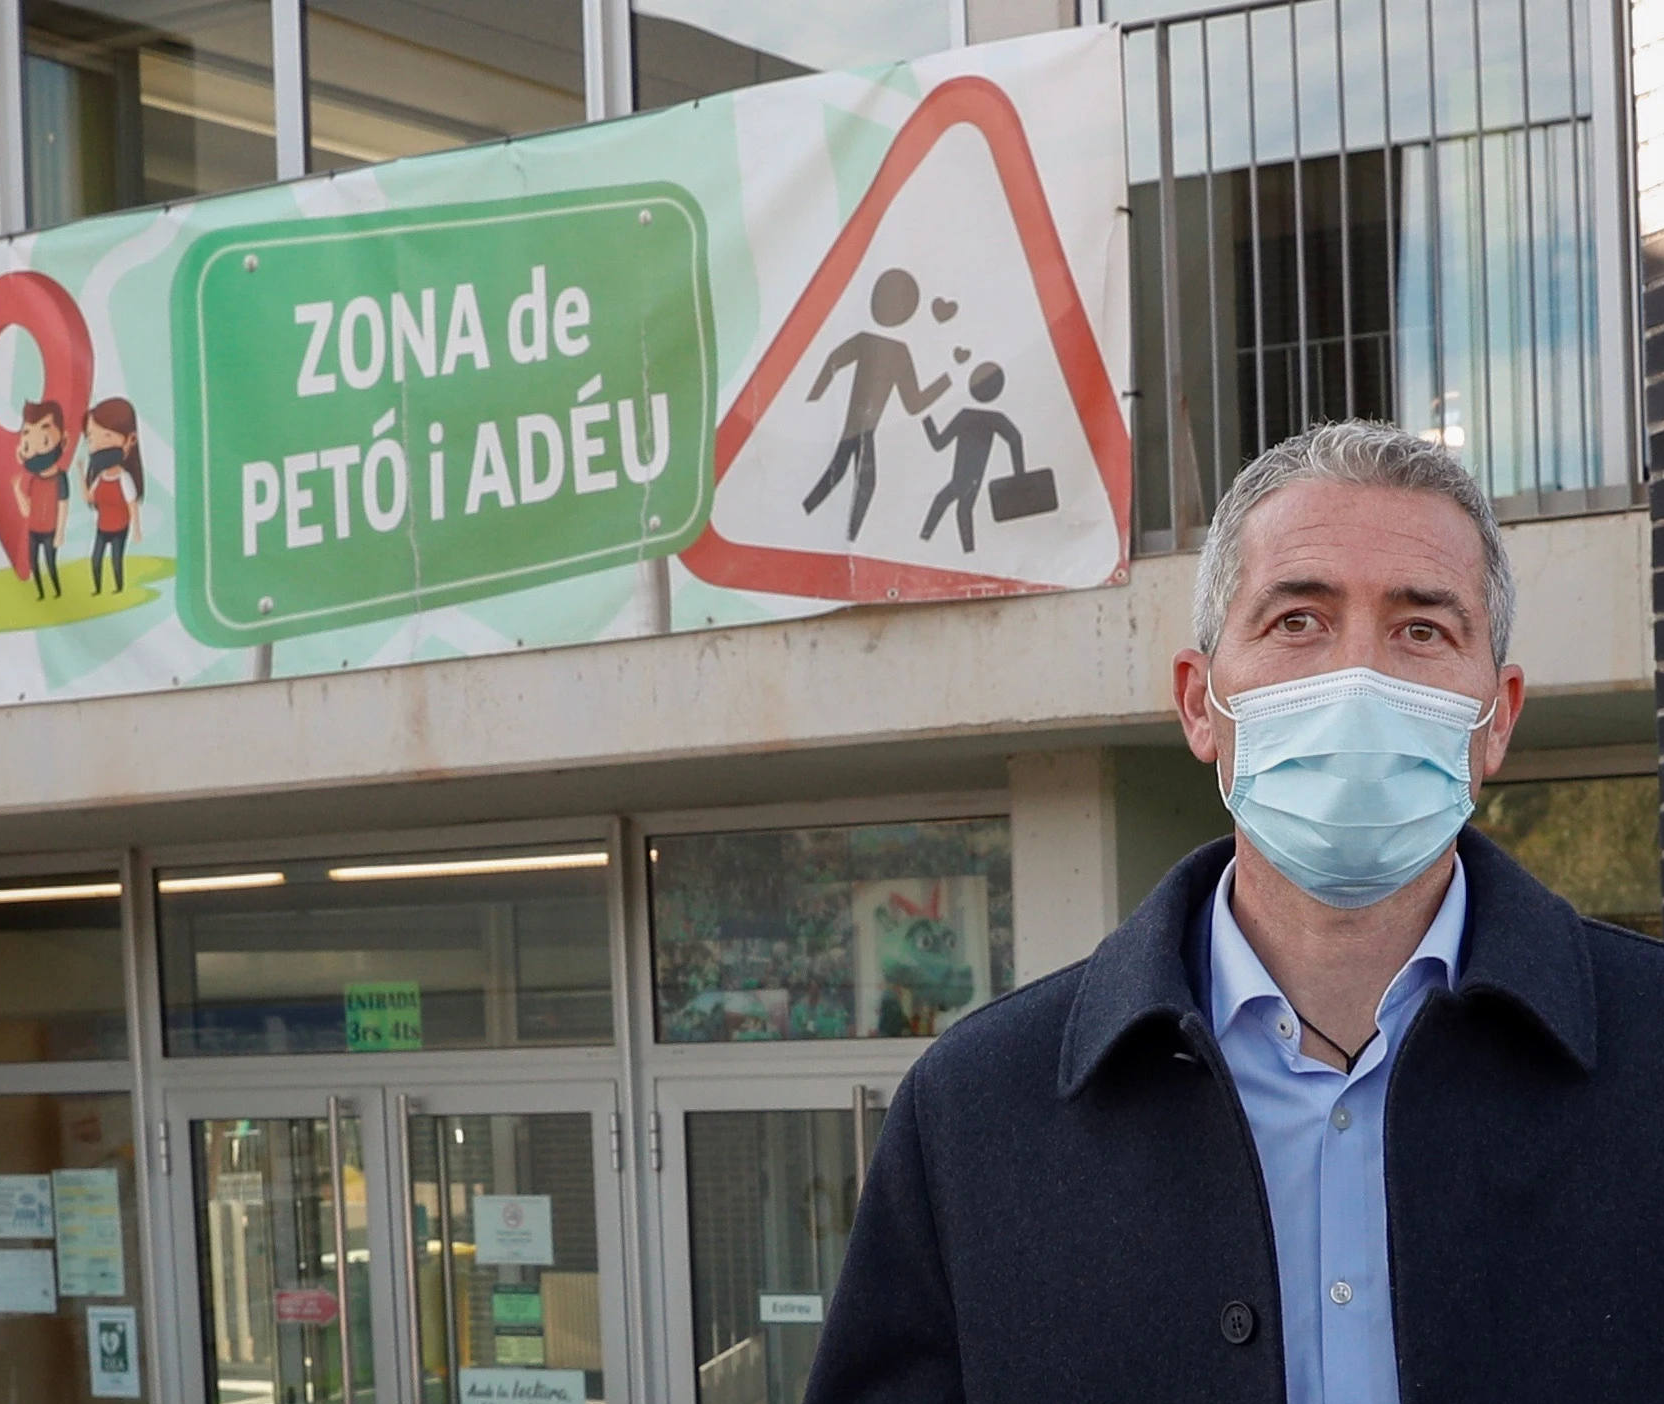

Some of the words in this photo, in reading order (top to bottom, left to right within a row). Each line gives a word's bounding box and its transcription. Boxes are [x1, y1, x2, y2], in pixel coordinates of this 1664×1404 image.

[293, 283, 491, 398] ZONA
[507, 264, 592, 365] de
[241, 406, 409, 557] PETÓ
[428, 421, 446, 522] i
[464, 372, 671, 516] ADÉU
[347, 991, 420, 1011] ENTRADA
